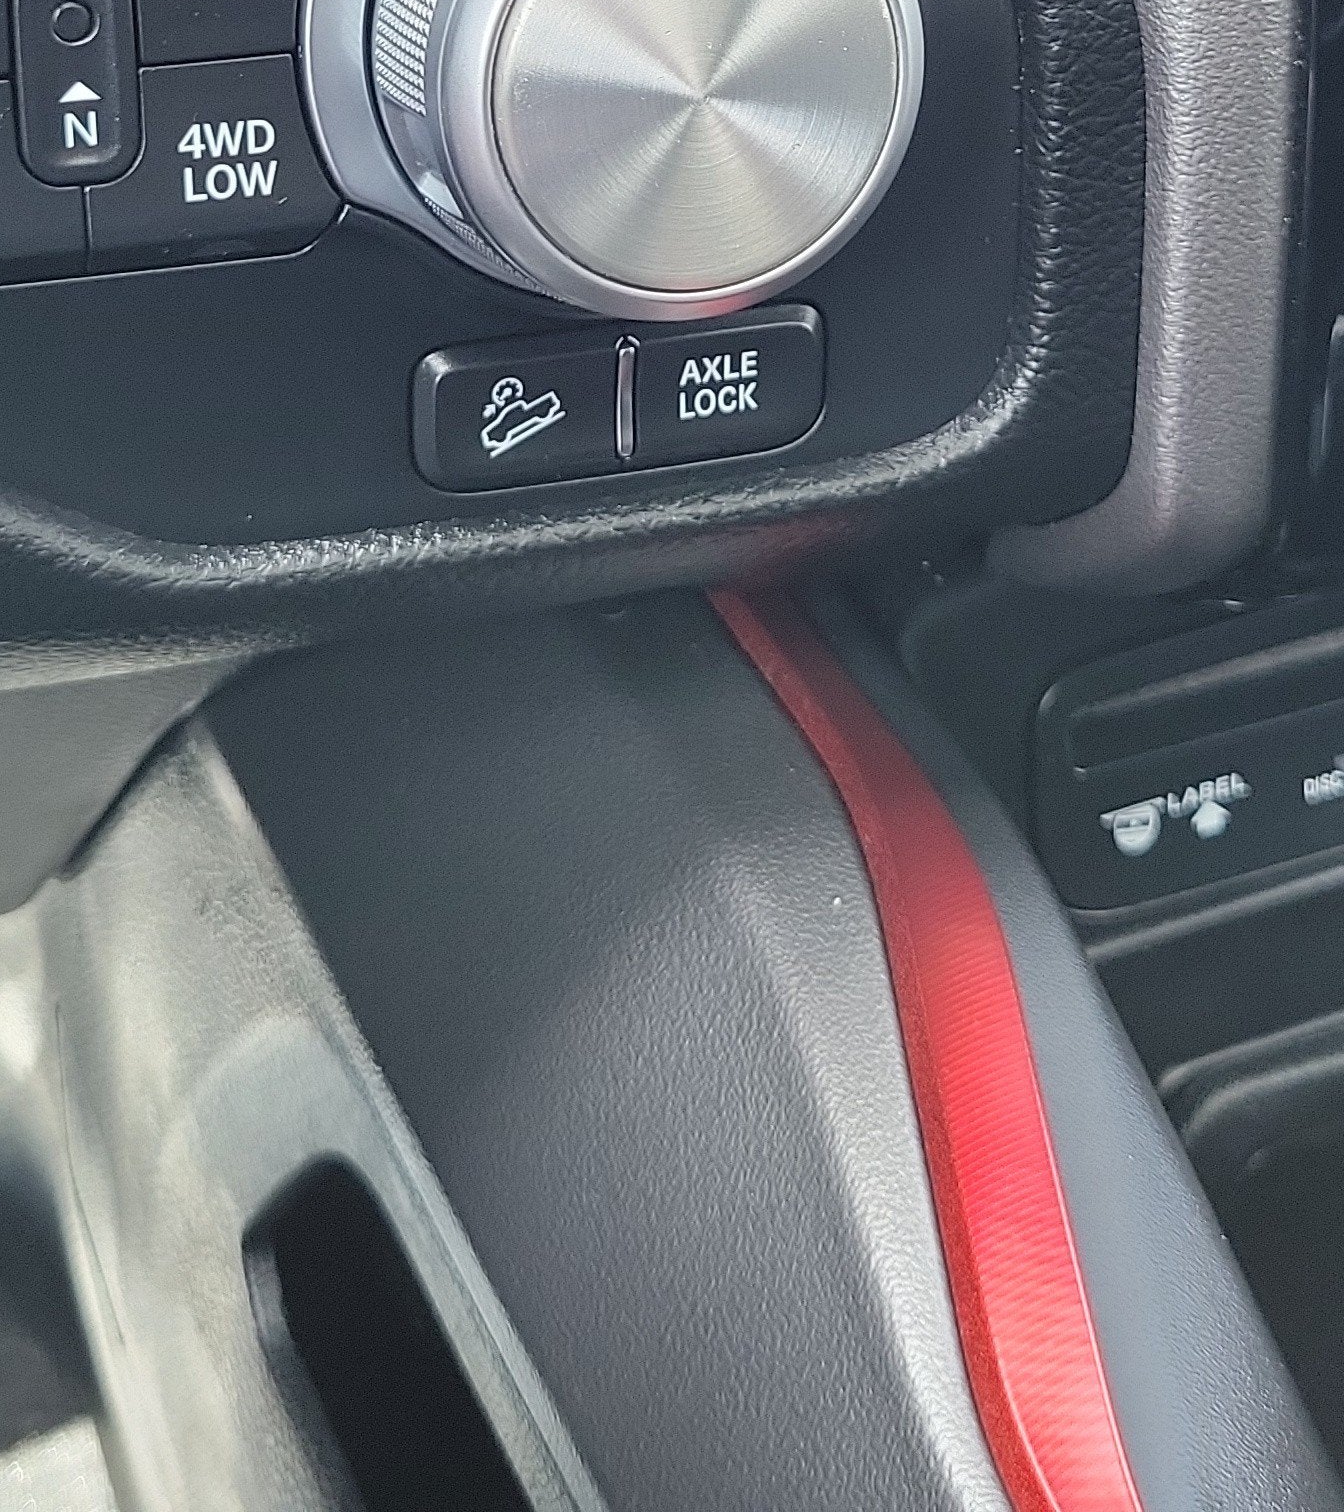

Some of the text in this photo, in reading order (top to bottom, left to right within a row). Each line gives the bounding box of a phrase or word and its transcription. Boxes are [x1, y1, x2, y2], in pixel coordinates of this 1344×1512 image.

[63, 111, 98, 149] N
[177, 119, 275, 160] 4WD
[182, 160, 277, 204] LOW
[679, 350, 758, 387] AXLE
[679, 381, 758, 420] LOCK
[1167, 772, 1252, 818] LABEL
